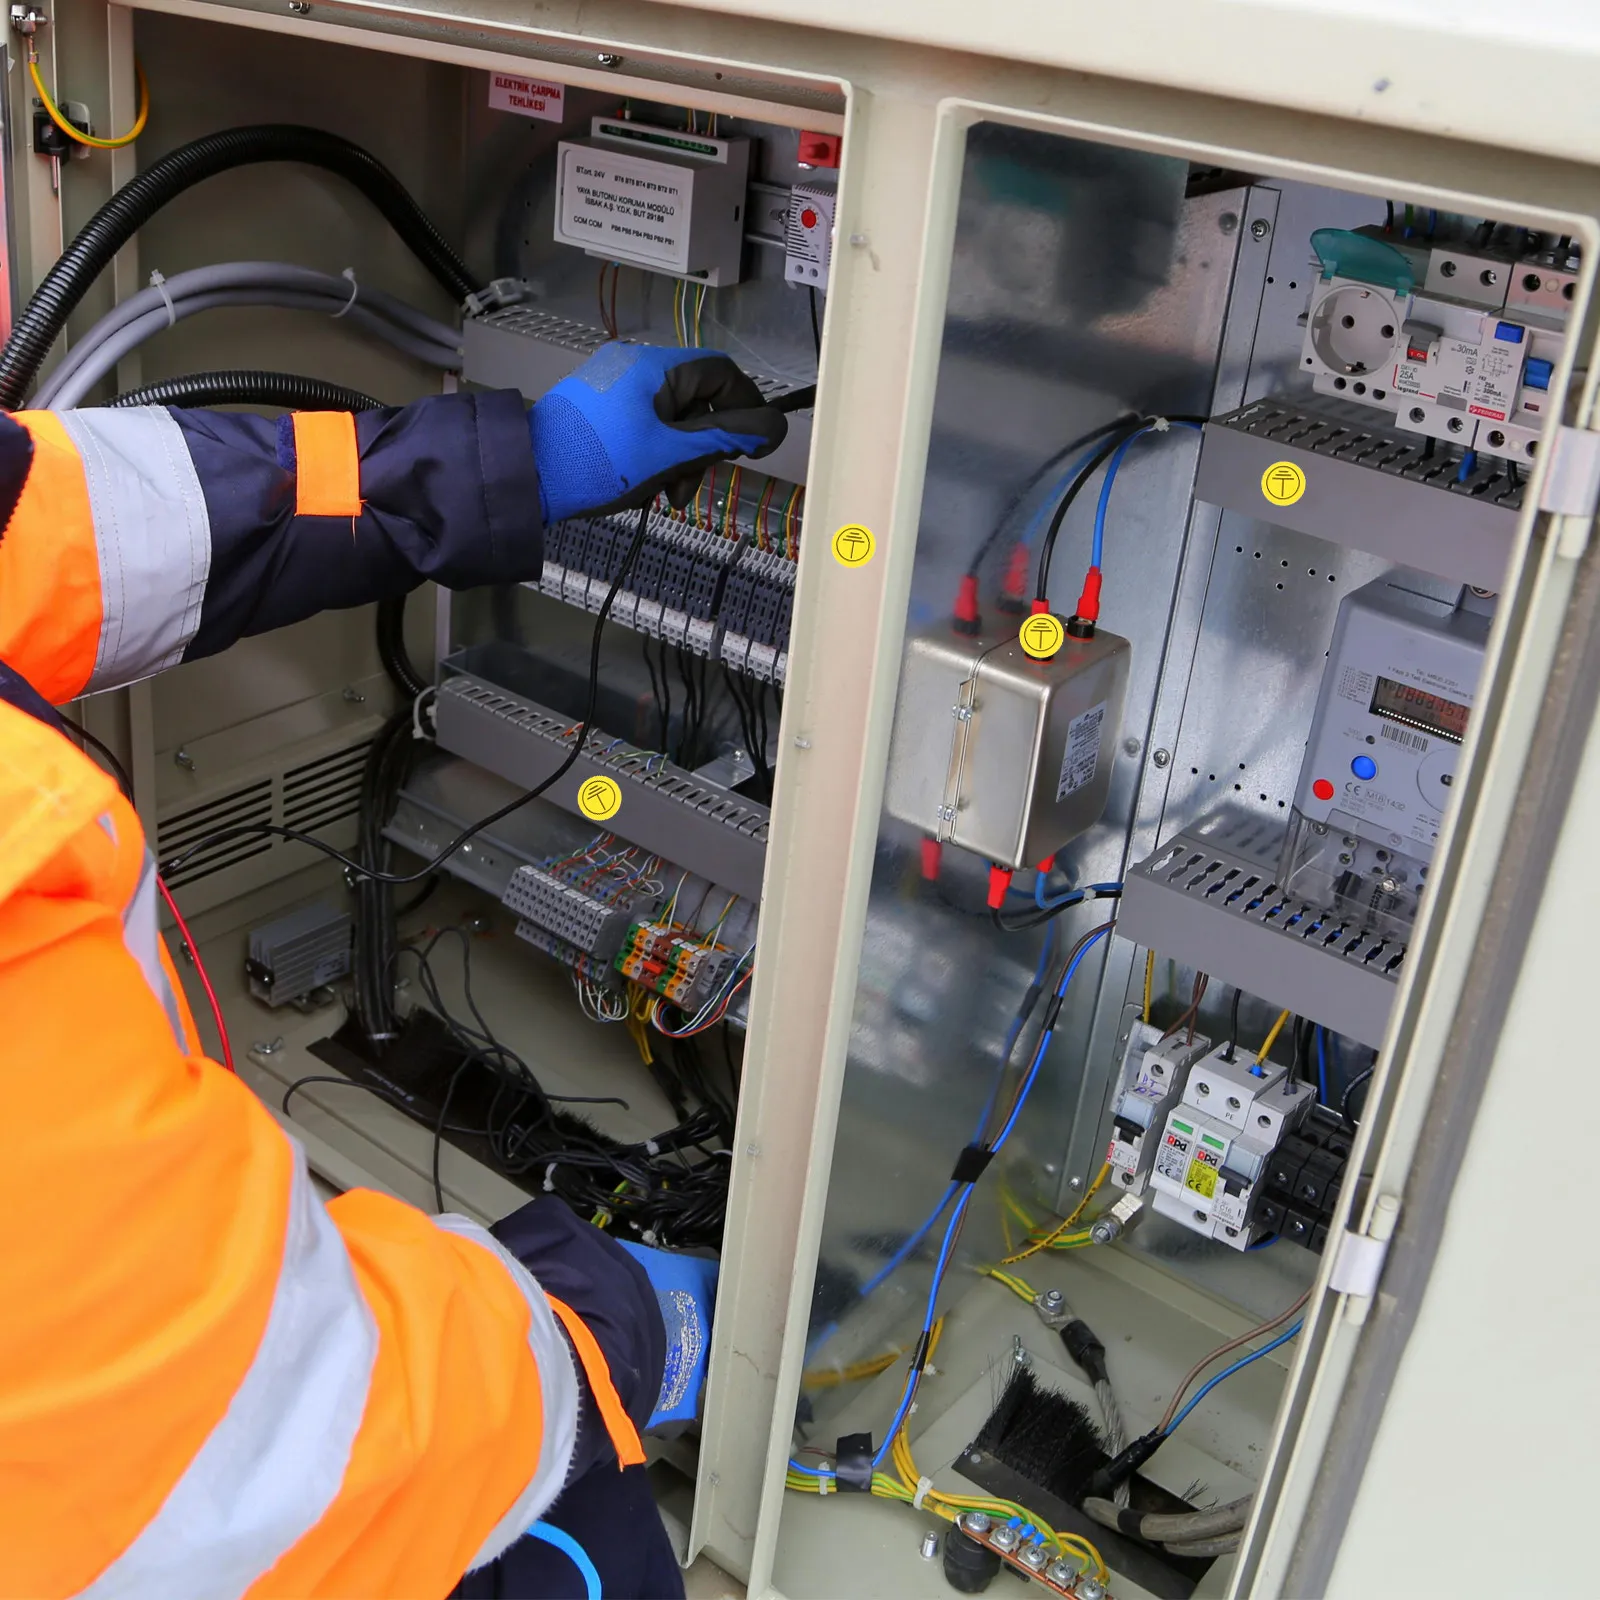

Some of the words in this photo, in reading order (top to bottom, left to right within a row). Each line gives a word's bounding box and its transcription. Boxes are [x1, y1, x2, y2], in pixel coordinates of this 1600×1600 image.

[495, 77, 529, 93] ELEKTRİK
[531, 84, 561, 100] ÇARPMA
[509, 94, 546, 112] TEHLİKESİ
[636, 179, 646, 189] BT4
[668, 186, 679, 196] BT1
[576, 186, 591, 195] YAYA
[592, 188, 617, 202] BUTONU
[619, 195, 646, 209] KORUMA
[646, 202, 675, 216] MODÜLÜ
[633, 207, 646, 218] BUT
[573, 215, 588, 225] COM
[588, 219, 603, 229] COM
[632, 229, 643, 238] PB4
[664, 236, 675, 246] PB1
[1456, 343, 1479, 357] 30mA
[1399, 369, 1415, 381] 25A
[1476, 407, 1504, 419] FEDERAL
[1225, 1112, 1234, 1120] PE
